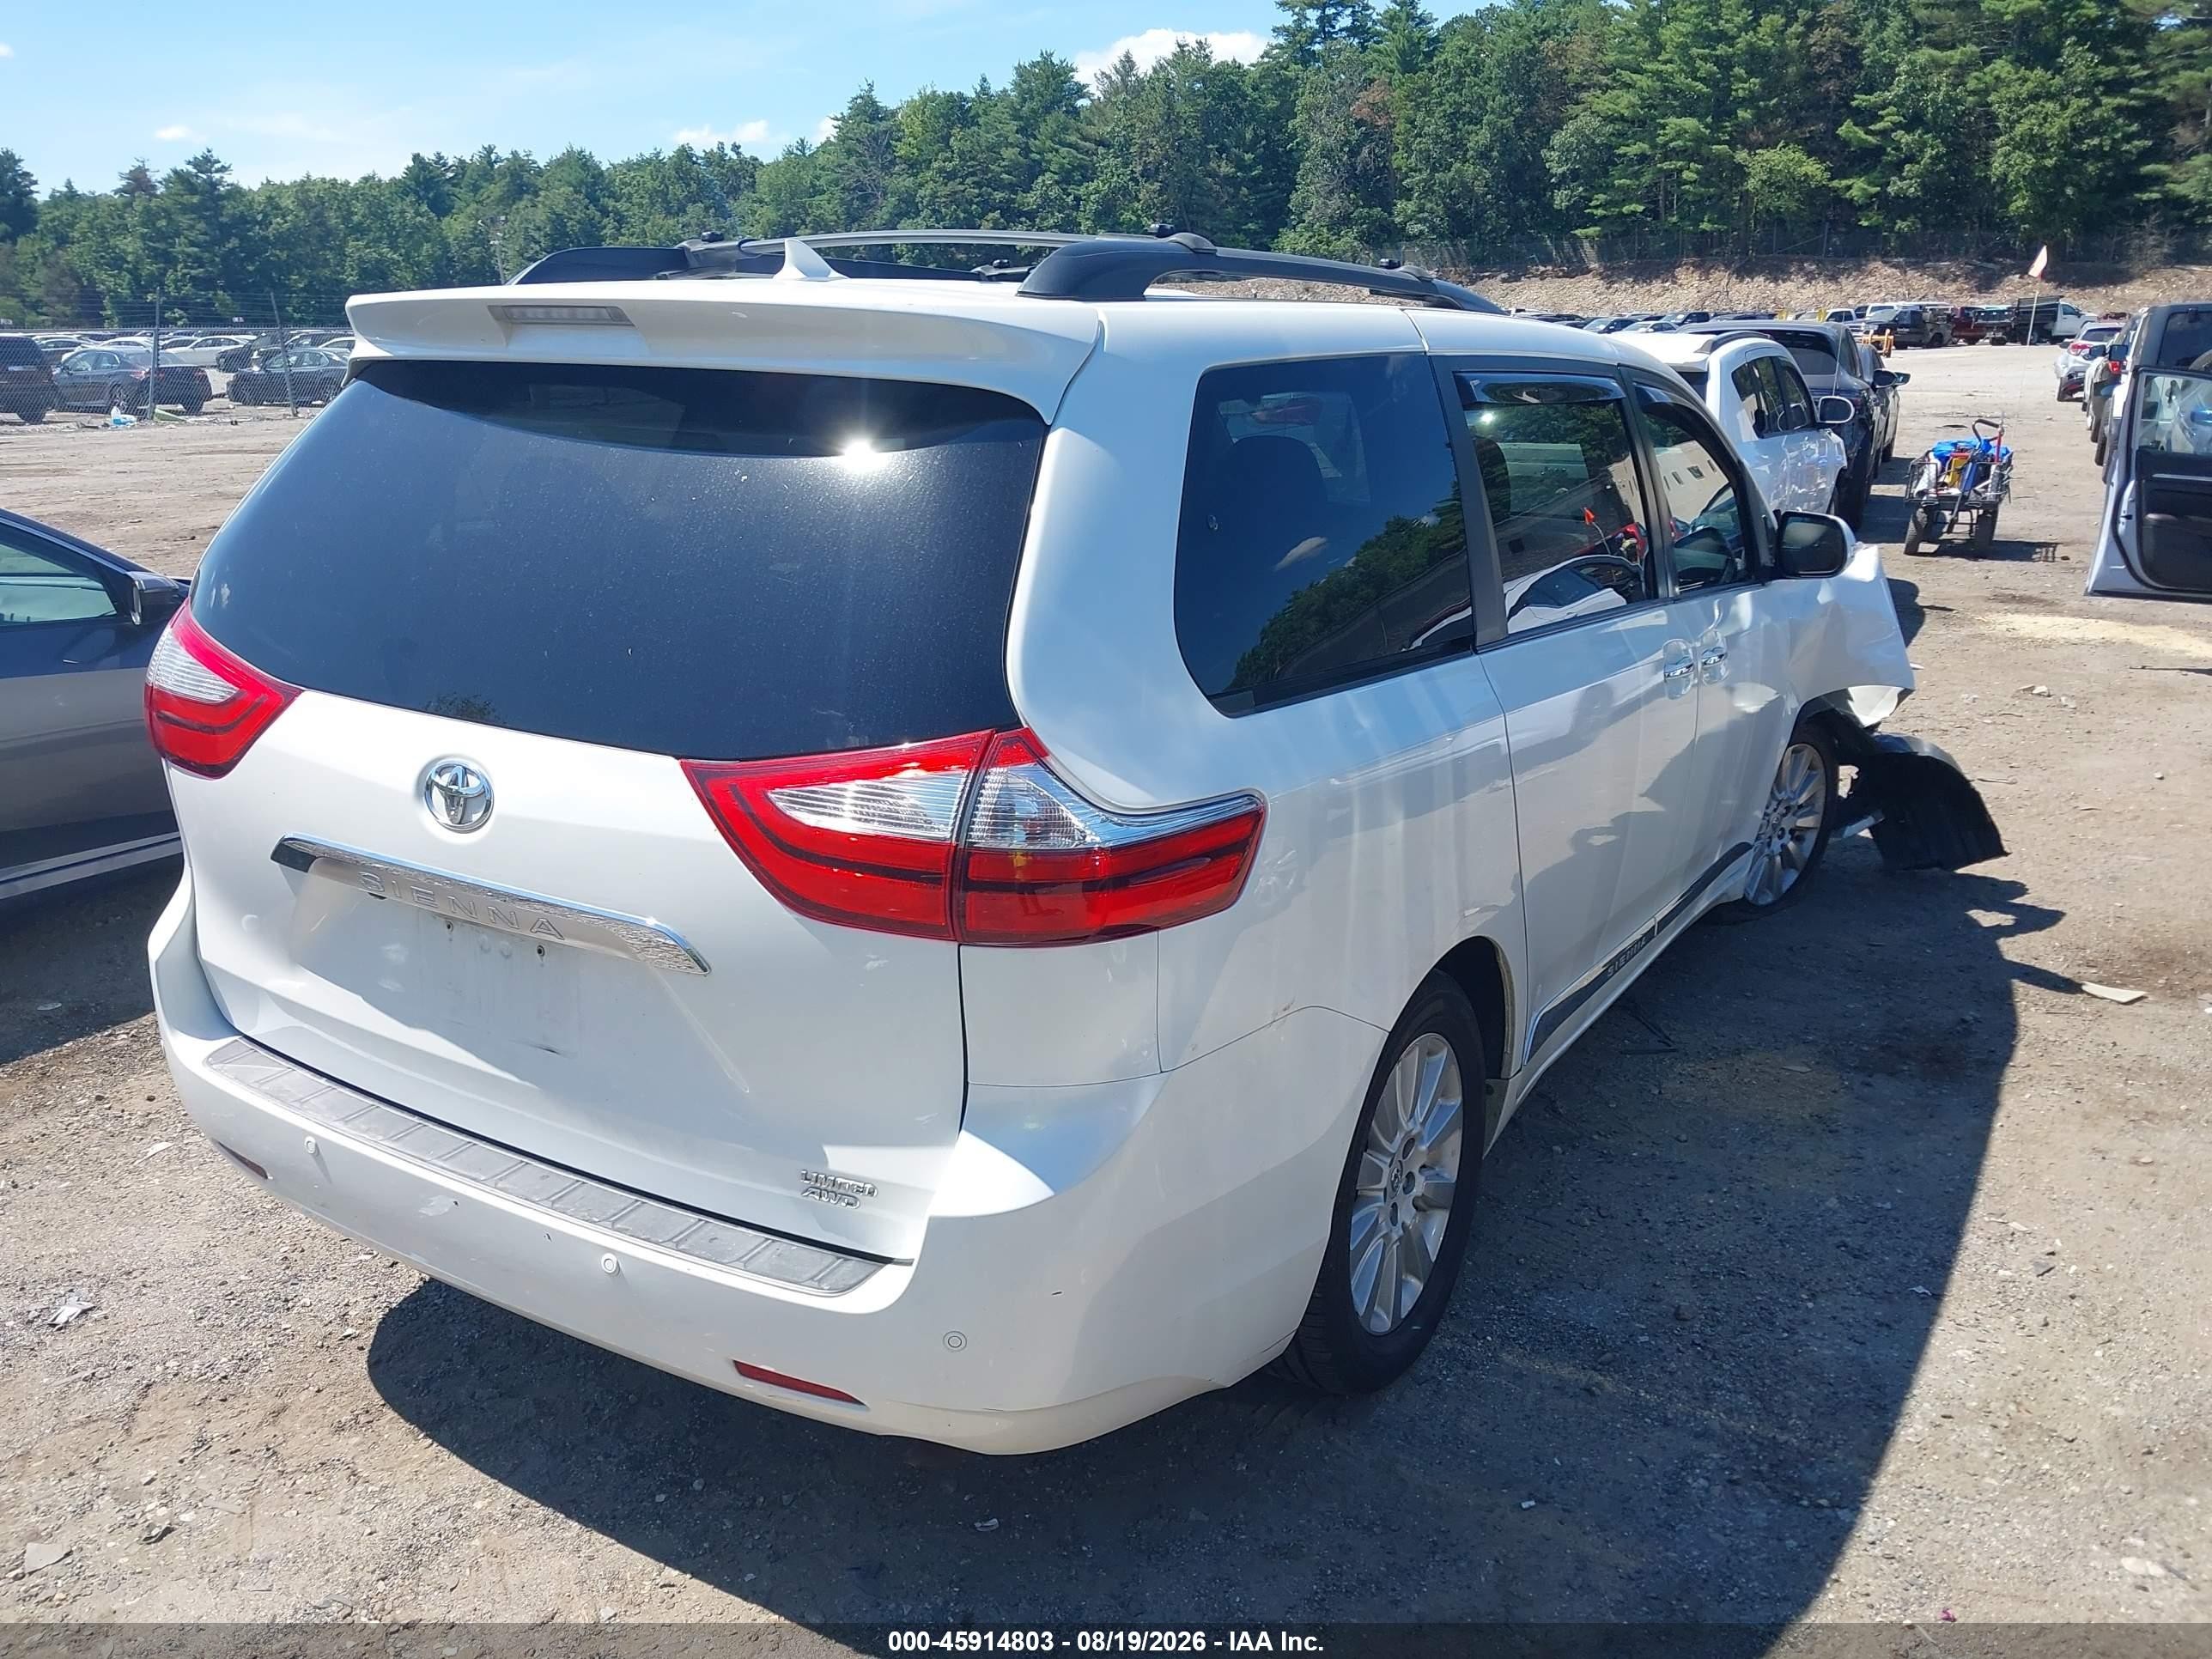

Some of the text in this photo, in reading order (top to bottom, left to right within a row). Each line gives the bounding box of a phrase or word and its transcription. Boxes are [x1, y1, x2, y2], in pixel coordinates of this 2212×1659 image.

[356, 871, 566, 941] SIENNA
[799, 1169, 878, 1197] LIMITED
[800, 1186, 861, 1209] AWD
